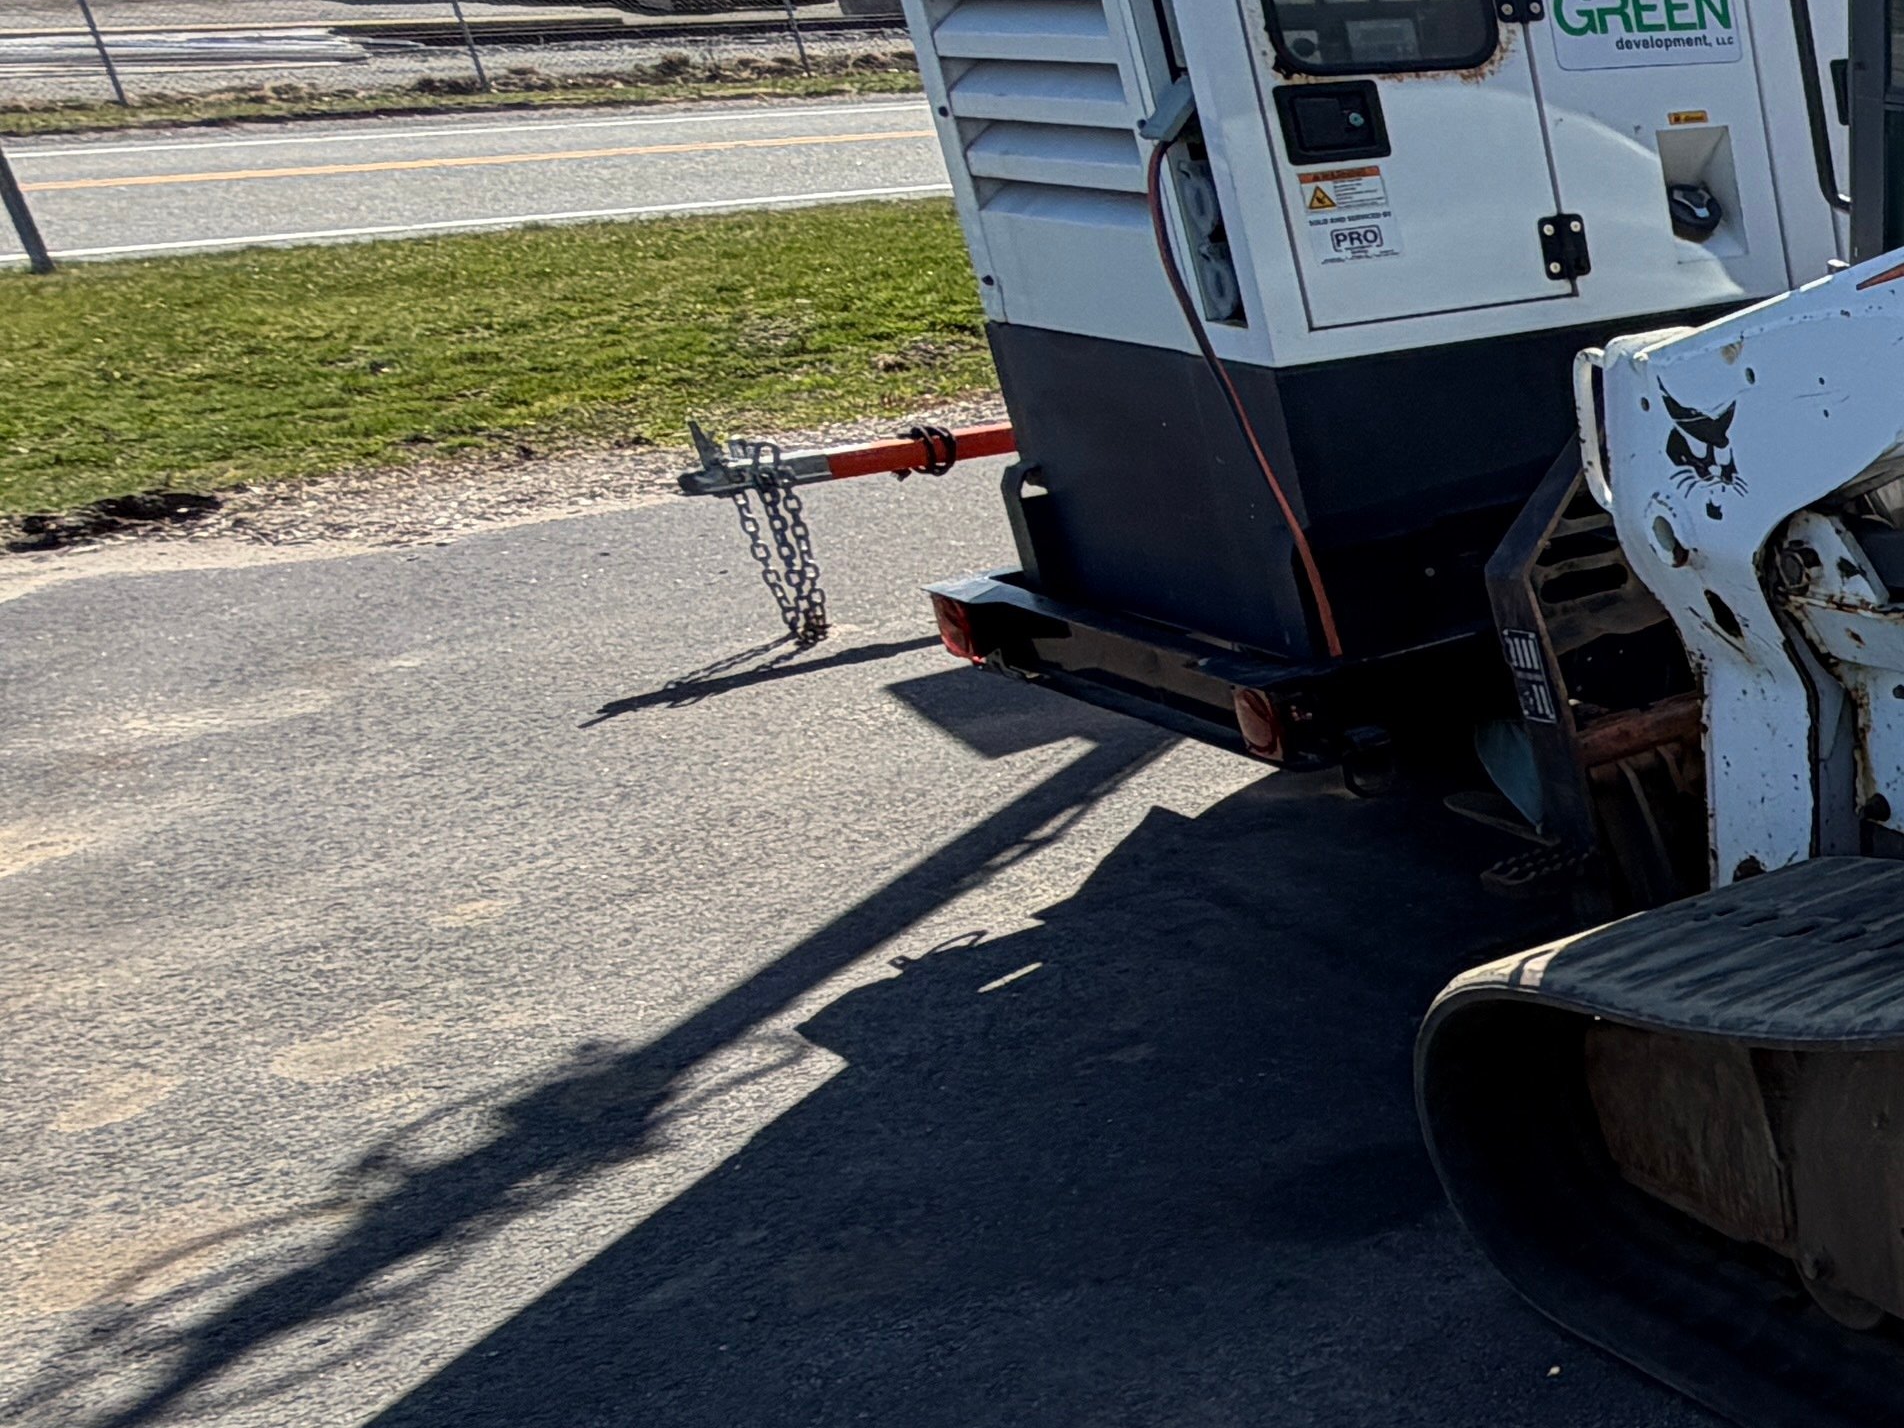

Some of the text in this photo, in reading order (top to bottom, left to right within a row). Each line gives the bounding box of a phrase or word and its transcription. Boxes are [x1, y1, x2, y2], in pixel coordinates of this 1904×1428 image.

[1615, 34, 1734, 51] development, LLC
[1334, 229, 1378, 248] PRO
